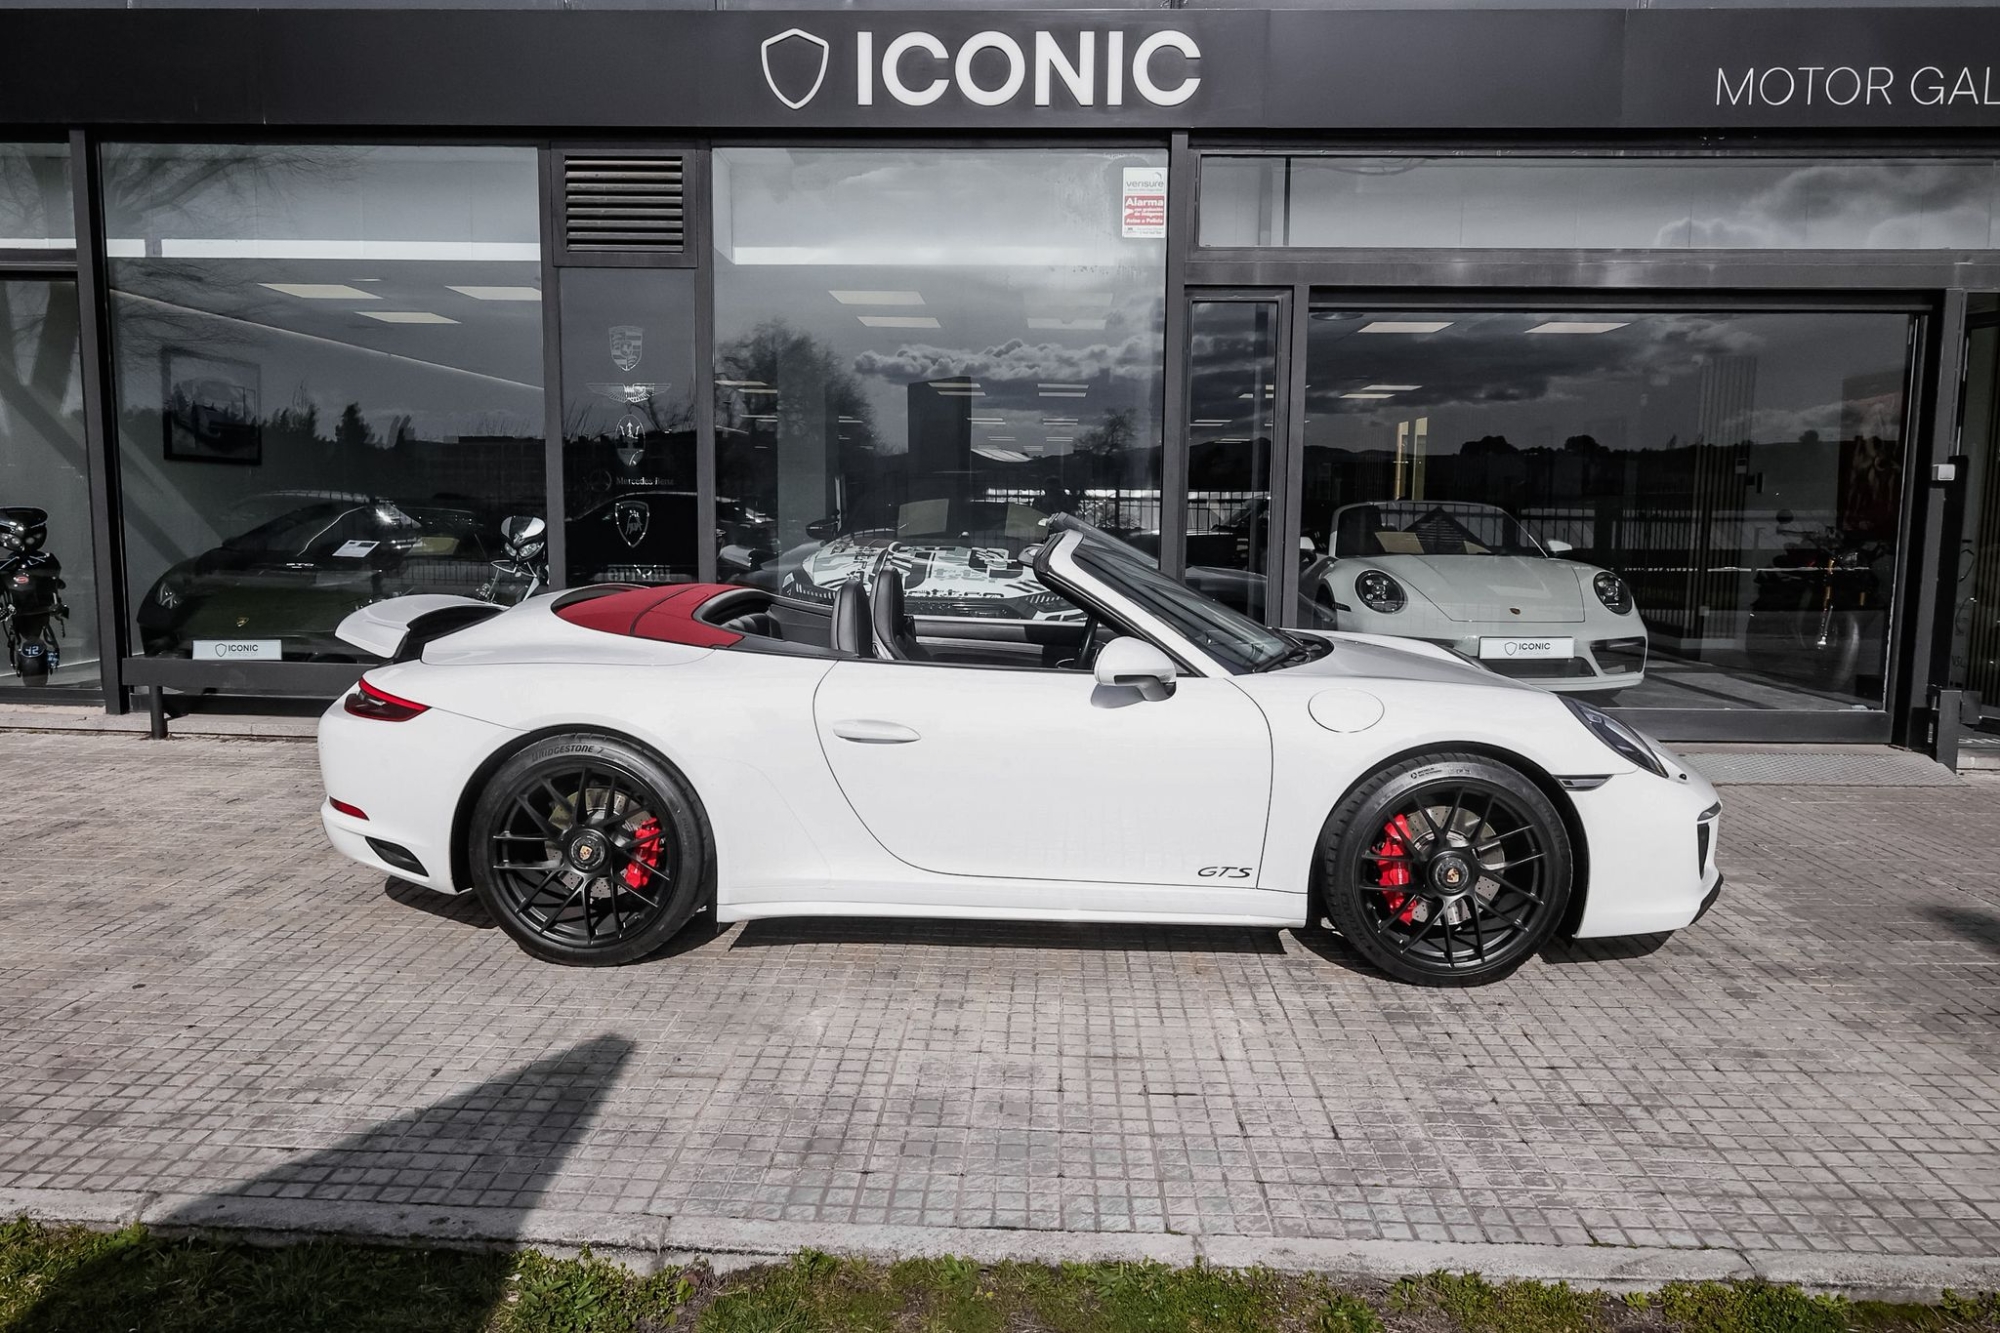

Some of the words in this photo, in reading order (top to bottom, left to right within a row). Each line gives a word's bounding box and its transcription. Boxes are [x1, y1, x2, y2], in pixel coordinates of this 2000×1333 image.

[857, 29, 1201, 107] ICONIC
[1716, 66, 1894, 106] MOTOR
[1911, 66, 2000, 106] GAL
[1125, 197, 1164, 207] Alarma
[607, 564, 671, 582] errari
[228, 644, 259, 652] ICONIC
[1518, 642, 1551, 650] ICONIC
[1198, 866, 1253, 878] GTS
